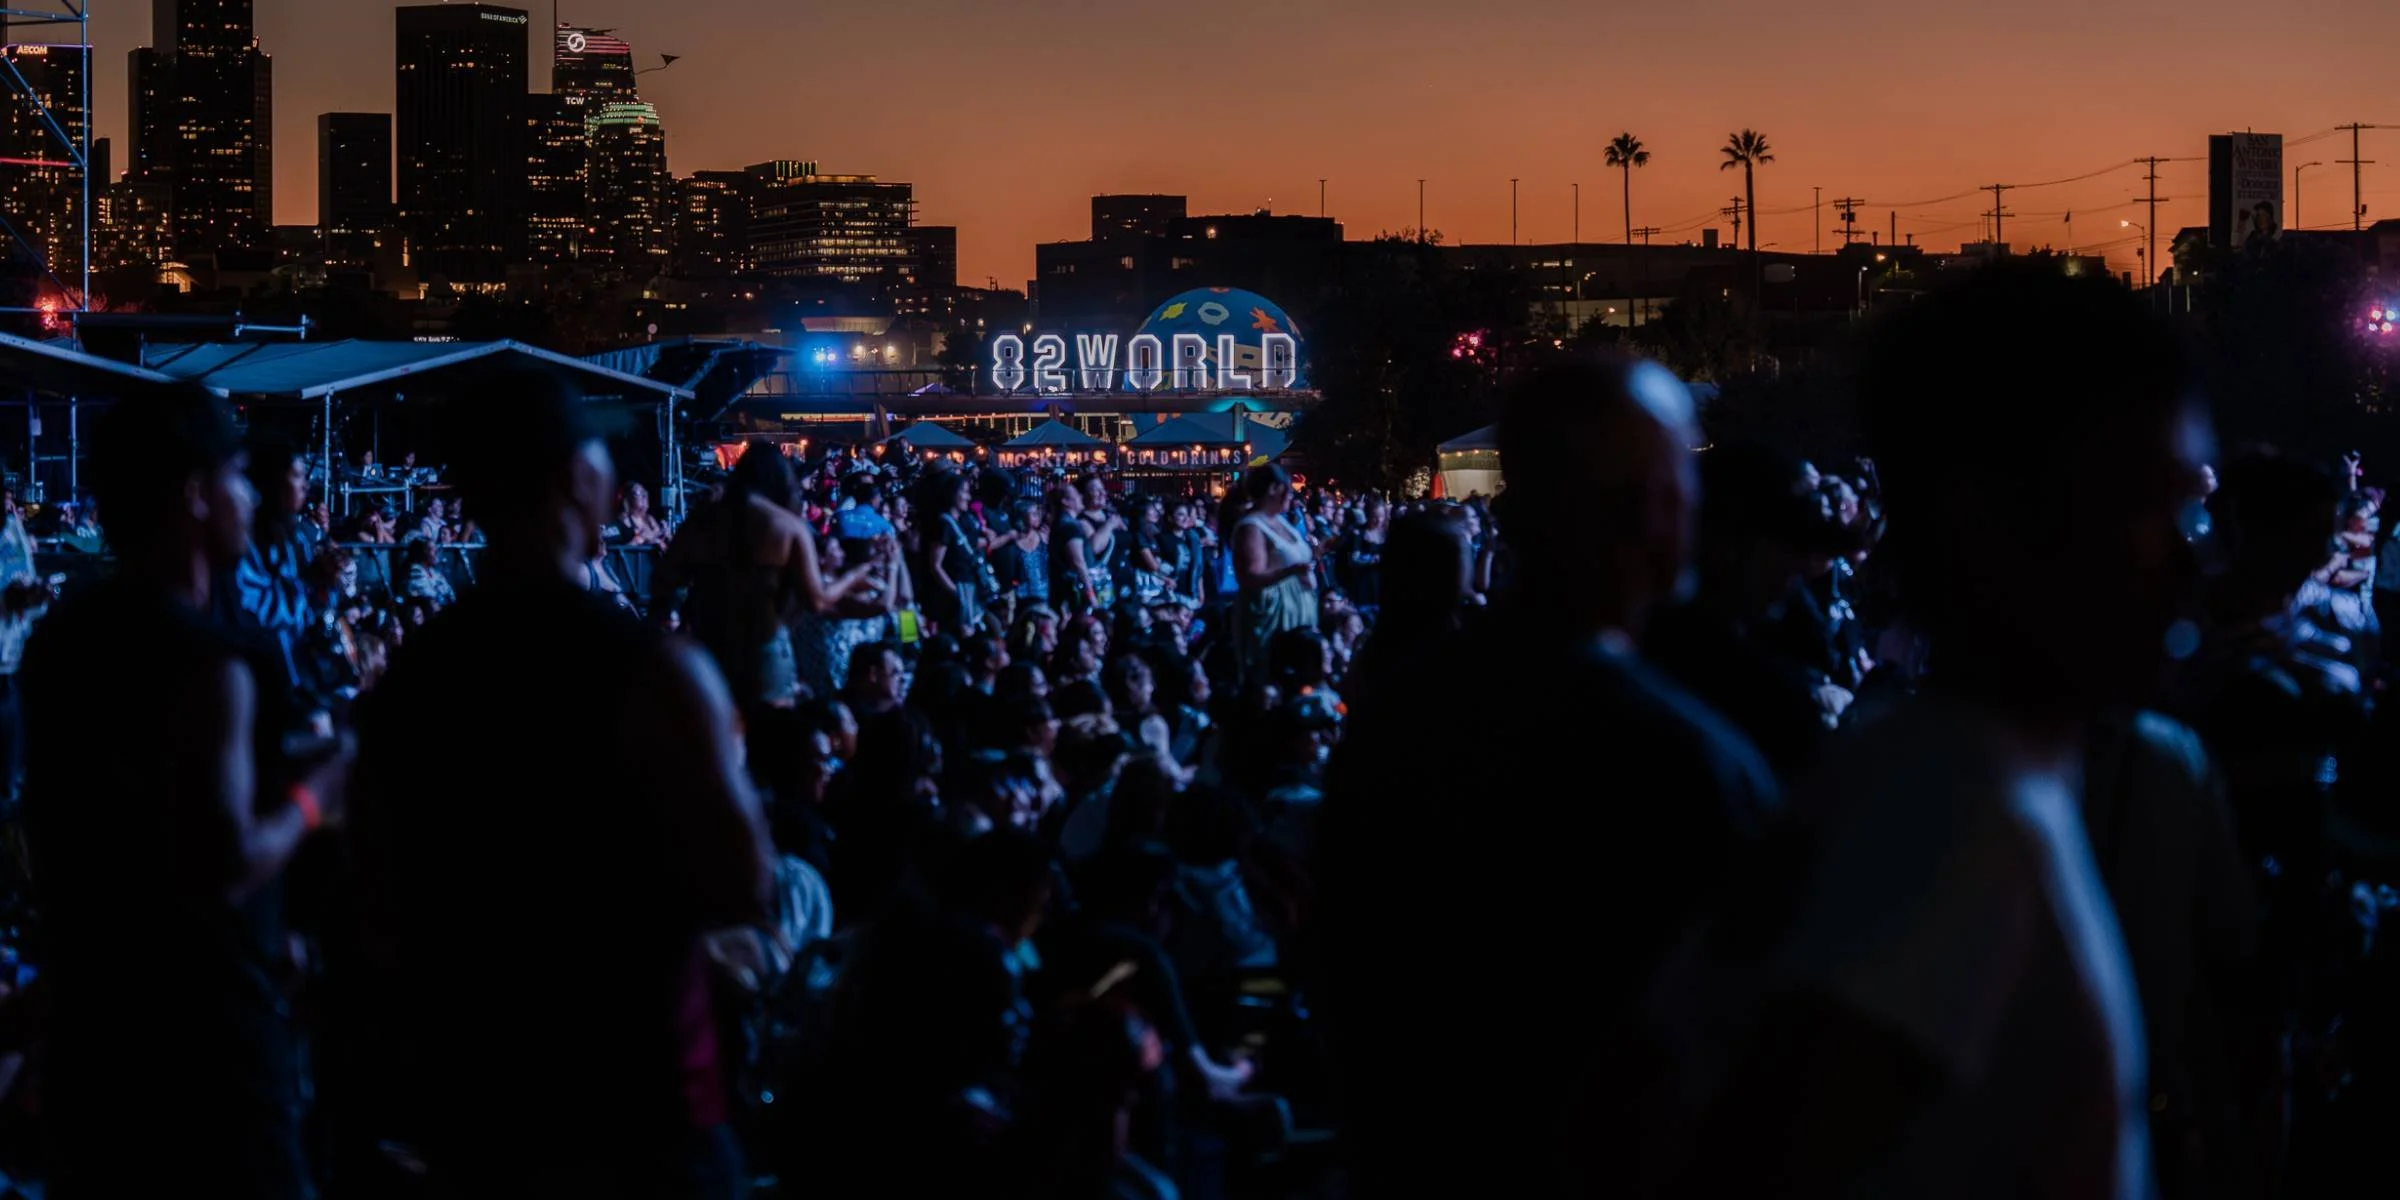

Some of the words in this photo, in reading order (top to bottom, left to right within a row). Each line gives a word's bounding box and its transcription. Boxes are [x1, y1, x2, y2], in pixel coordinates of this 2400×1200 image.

[16, 45, 48, 55] AECOM
[565, 97, 584, 105] TCW
[1127, 450, 1169, 465] COLD
[1179, 450, 1241, 465] DRINKS
